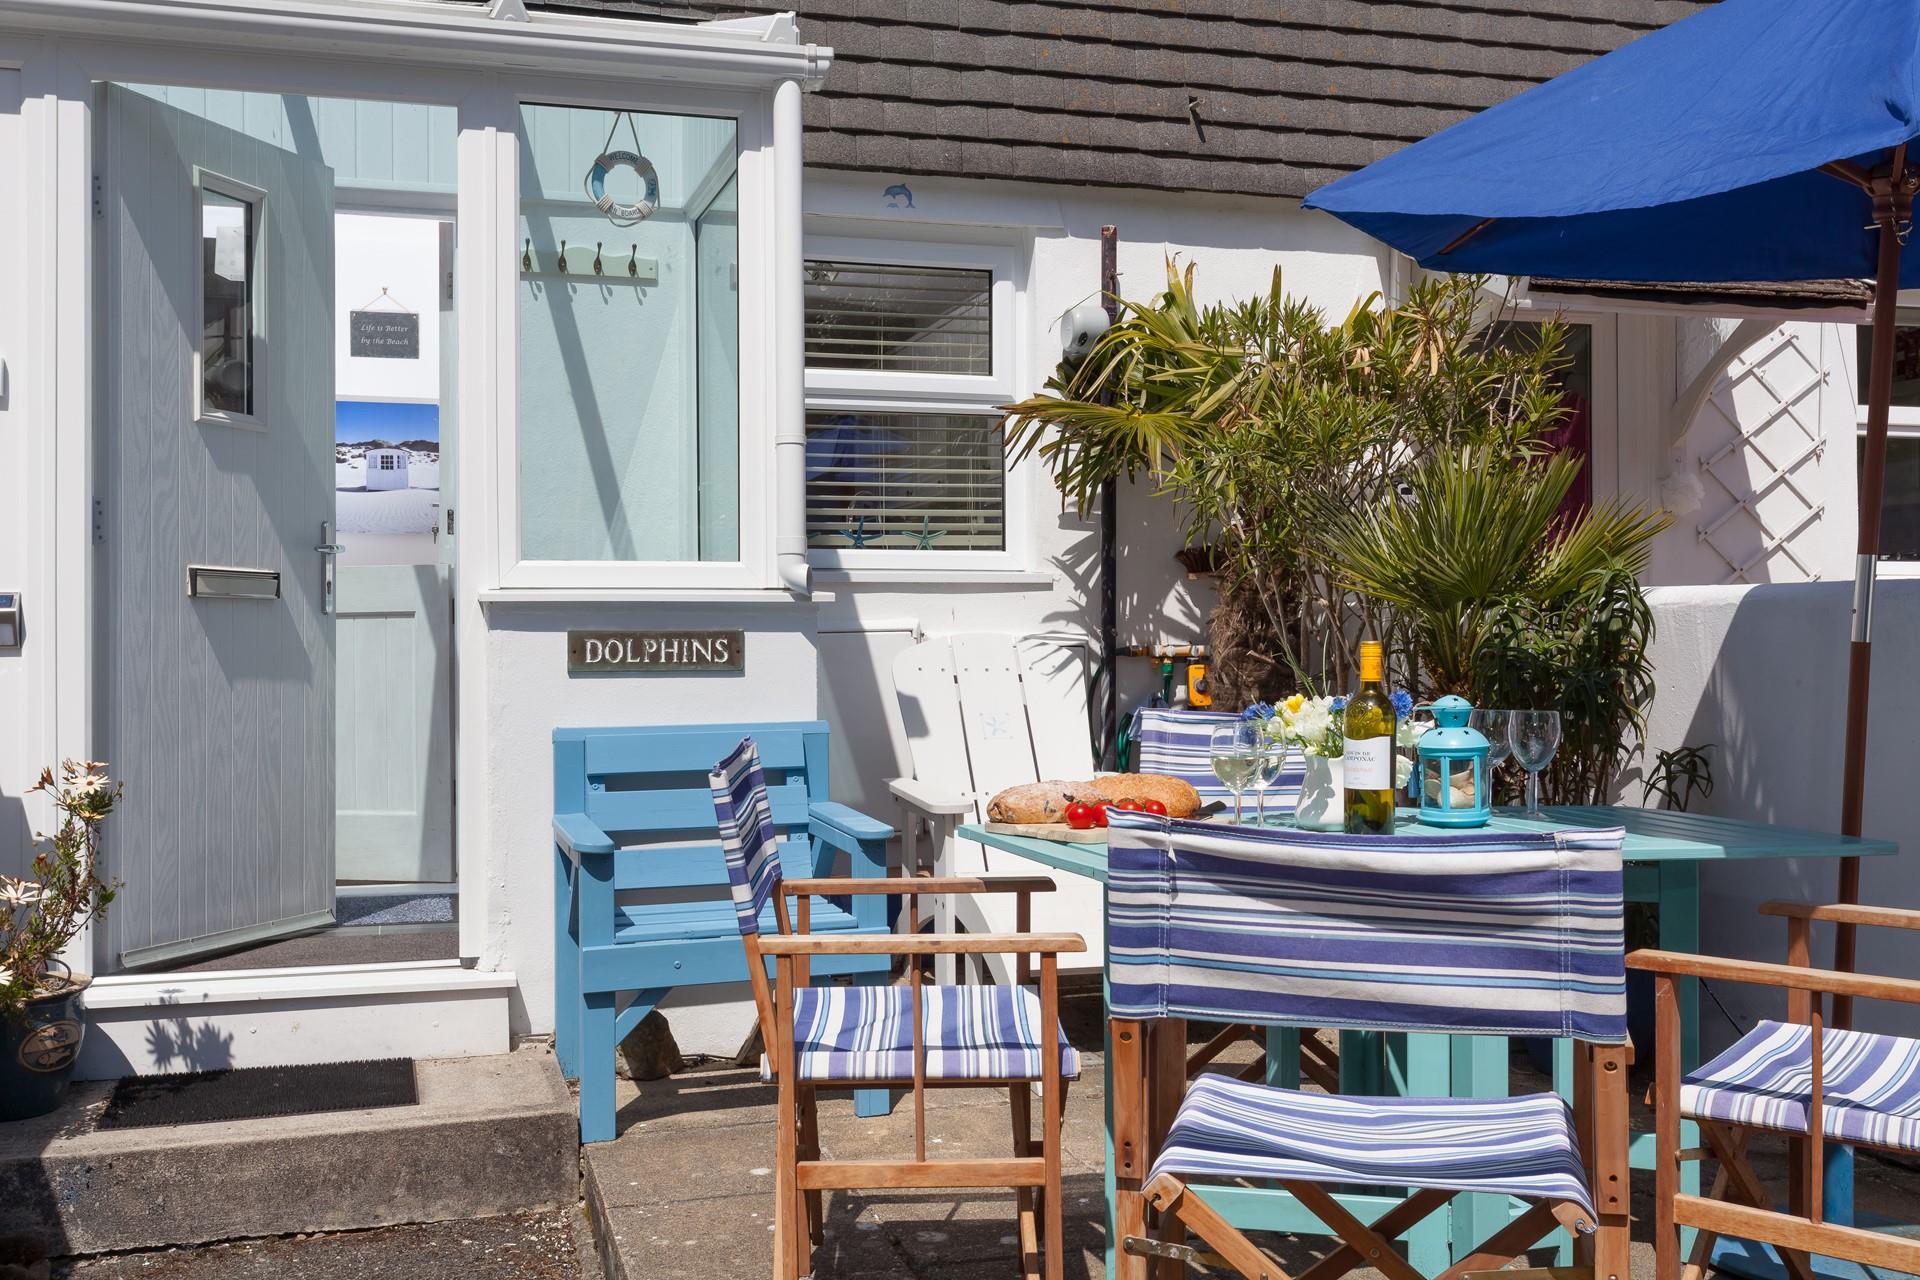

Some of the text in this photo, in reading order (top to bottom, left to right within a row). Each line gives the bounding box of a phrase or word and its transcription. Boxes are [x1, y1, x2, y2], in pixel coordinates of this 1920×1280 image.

[360, 324, 375, 333] Life
[360, 336, 371, 345] by
[373, 336, 385, 345] the
[584, 638, 729, 664] DOLPHINS
